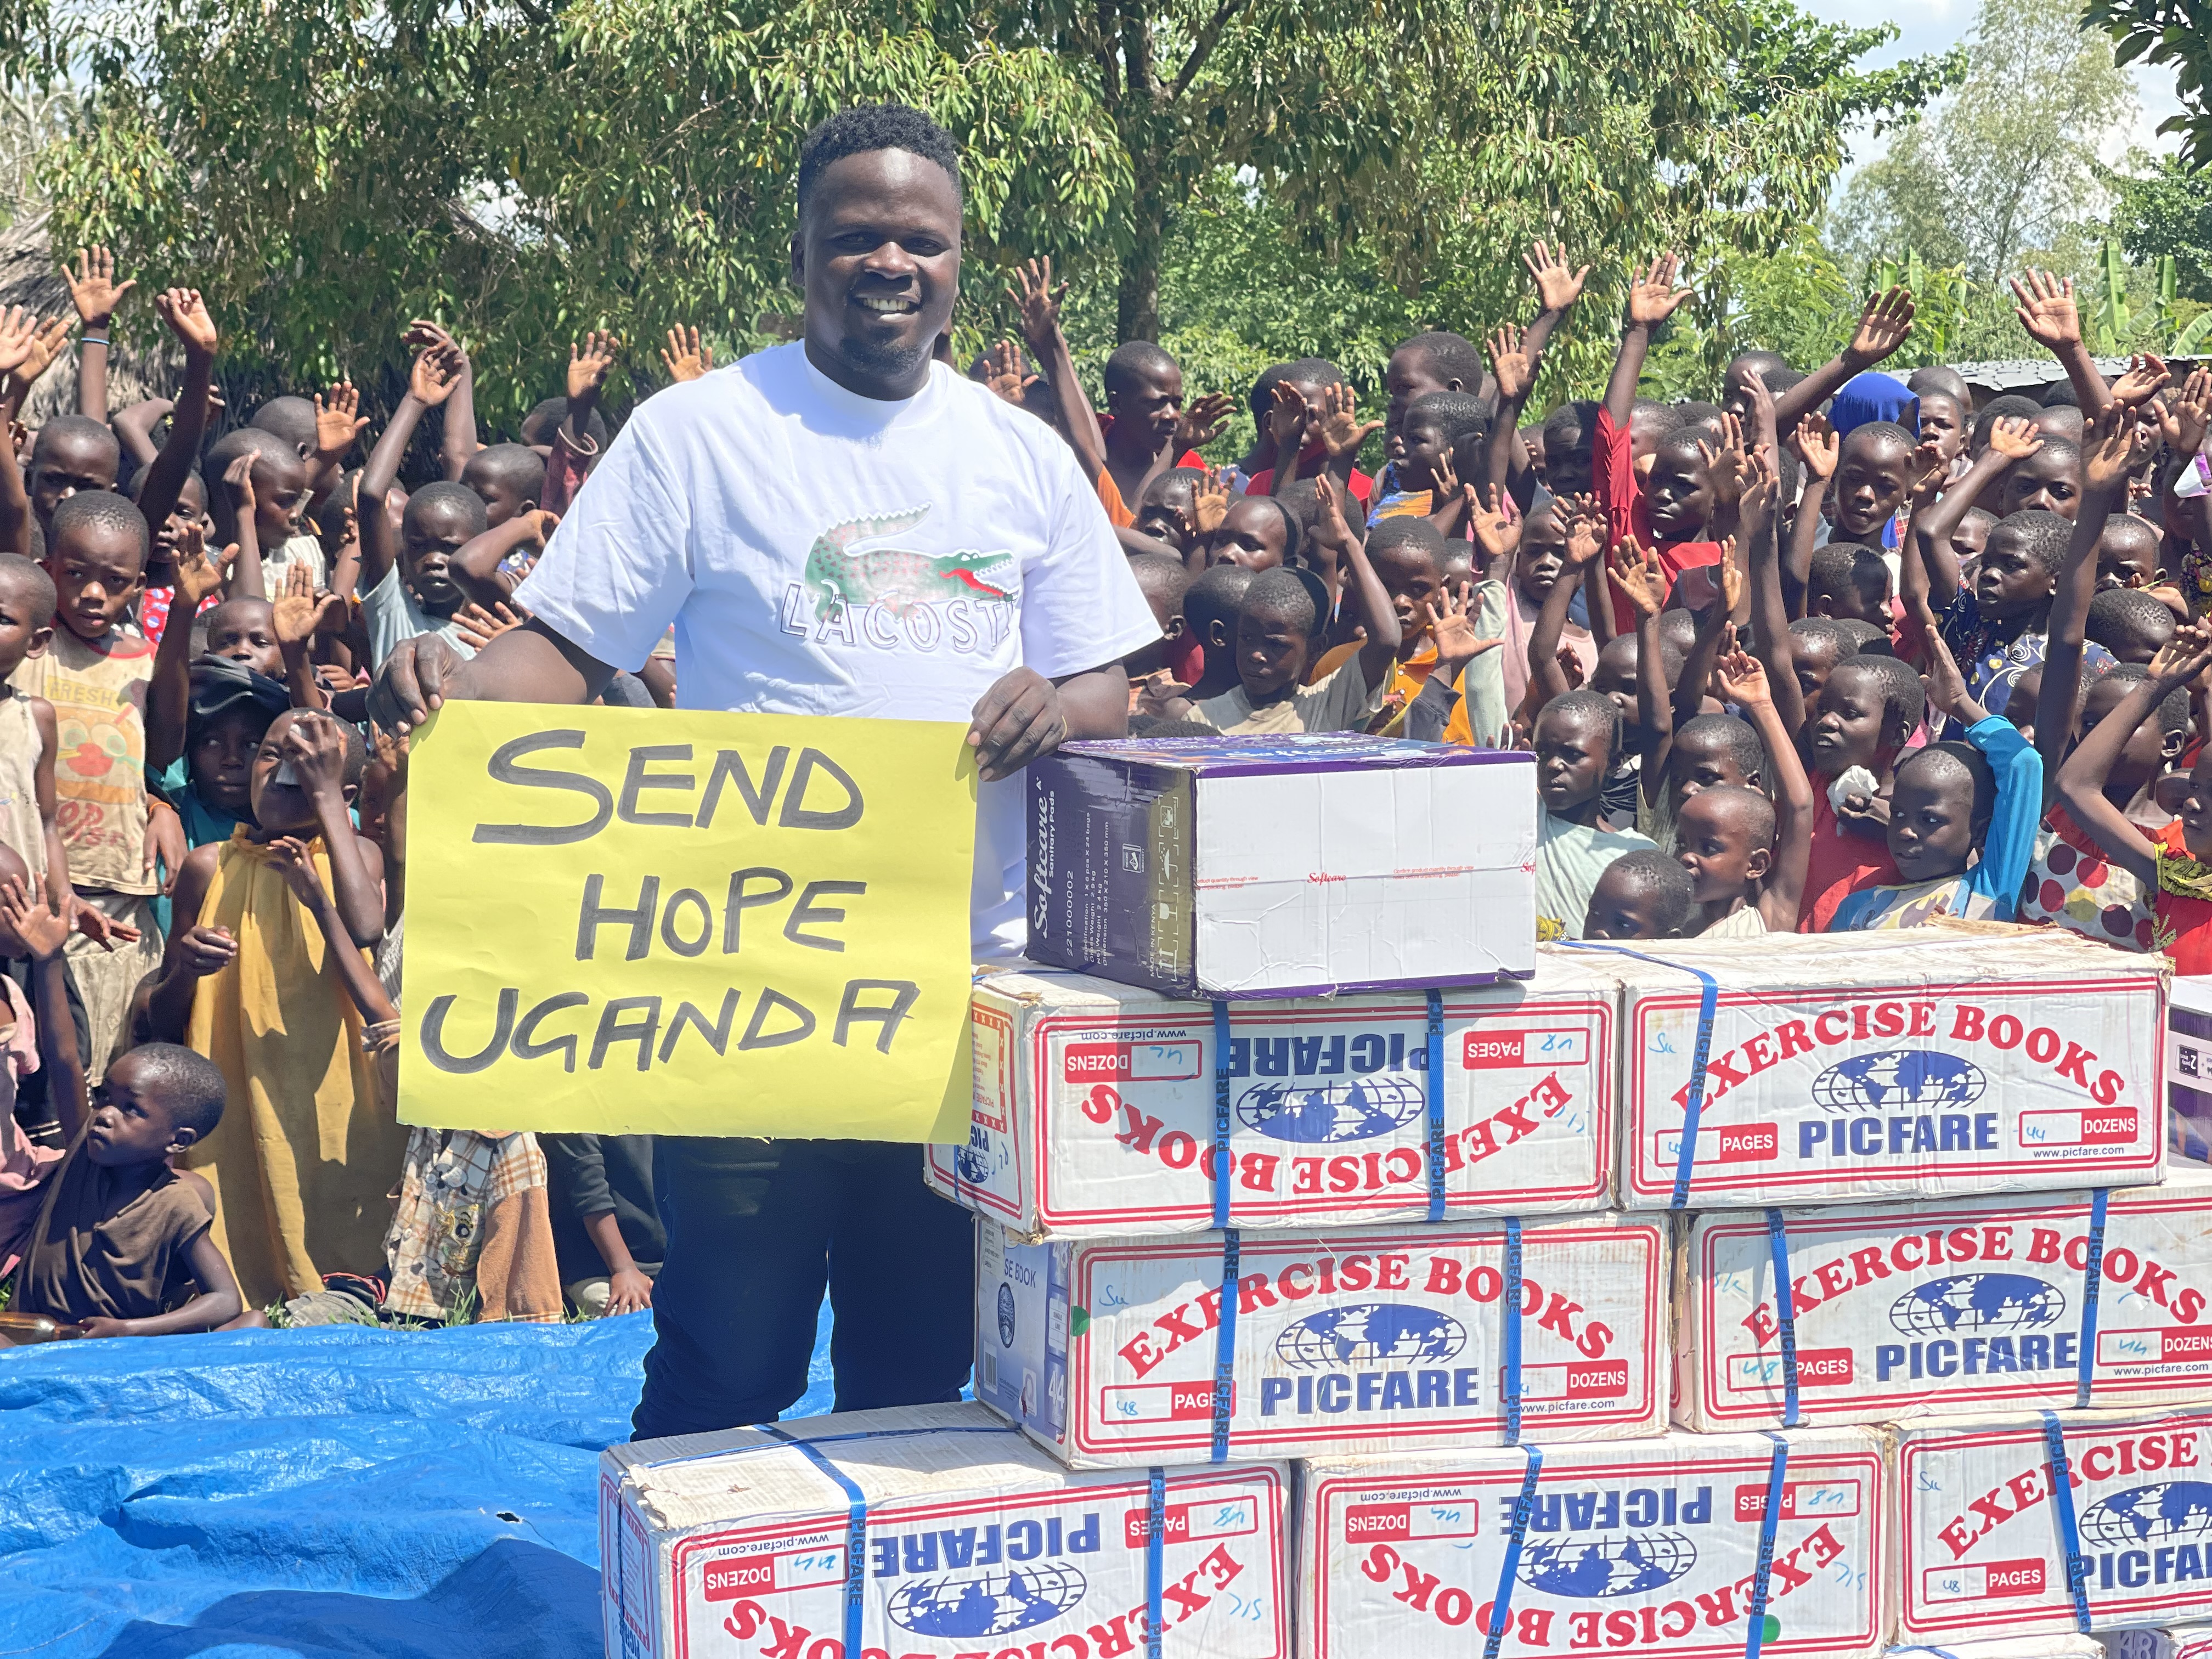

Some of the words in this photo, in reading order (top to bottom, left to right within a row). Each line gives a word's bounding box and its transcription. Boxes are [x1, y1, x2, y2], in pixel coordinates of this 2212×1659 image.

[48, 680, 113, 706] FRESH
[472, 729, 864, 844] SEND
[1034, 796, 1052, 939] Softcare
[1307, 872, 1347, 885] Softcare
[575, 867, 867, 961] HOPE
[1065, 870, 1074, 957] 221000002
[420, 979, 921, 1074] UGANDA
[1081, 1030, 1187, 1041] www.picfare.com
[1469, 1041, 1521, 1058] PAGES
[1068, 1055, 1128, 1071] DOZENS
[1229, 1032, 1430, 1077] PICFARE
[1670, 1001, 1937, 1116] EXERCISE
[1950, 1004, 2125, 1106] BOOKS
[1690, 1018, 1714, 1099] PICFARE
[1216, 1067, 1229, 1152] PICFARE
[1293, 1070, 1573, 1195] EXERCISE
[2084, 1116, 2137, 1135] DOZENS
[1081, 1084, 1280, 1193] BOOKS
[1430, 1116, 1444, 1199] PICFARE
[1722, 1133, 1774, 1152] PAGES
[1798, 1112, 1999, 1159] PICFARE
[2033, 1144, 2125, 1159] www.picfare.com
[1015, 1263, 1036, 1289] BOOK
[1508, 1232, 1521, 1313] PICFARE
[1741, 1226, 2014, 1348] EXERCISE
[2025, 1228, 2207, 1324] BOOKS
[2085, 1226, 2104, 1305] PICFARE
[1118, 1254, 1410, 1380] EXERCISE
[1424, 1256, 1613, 1359] BOOKS
[1779, 1318, 1798, 1397] PICFARE
[1797, 1358, 1849, 1377] PAGES
[1876, 1331, 2079, 1382] PICFARE
[2164, 1336, 2212, 1352] DOZEN
[1260, 1367, 1480, 1417] PICFARE
[1570, 1372, 1626, 1388] DOZENS
[2114, 1364, 2209, 1376] www.picfare.com
[1175, 1393, 1217, 1409] PAGE
[1214, 1363, 1233, 1446] PICFARE
[1520, 1398, 1615, 1414] www.picfare.com
[1149, 1466, 1164, 1538] ICFARE
[1361, 1488, 1462, 1502] www.picfare.com
[1499, 1486, 1712, 1535] PICFARE
[1510, 1462, 1541, 1544] PICFARE
[1740, 1493, 1792, 1511] PGES
[1937, 1432, 2198, 1561] EXERCISE
[718, 1533, 830, 1556] www.picfare.com
[870, 1513, 1101, 1578] PICFARE
[1130, 1516, 1185, 1536] PAES
[1348, 1514, 1407, 1532] DOZENS
[707, 1566, 771, 1590] DOZENS
[848, 1518, 866, 1605] PICFARE
[1568, 1522, 1846, 1648] EXERCISE
[1752, 1534, 1775, 1616] PICFARE
[1989, 1568, 2042, 1588] PAGES
[2066, 1542, 2212, 1593] PICFA
[1361, 1544, 1555, 1647] BOOKS
[2070, 1550, 2091, 1628] PICFARE
